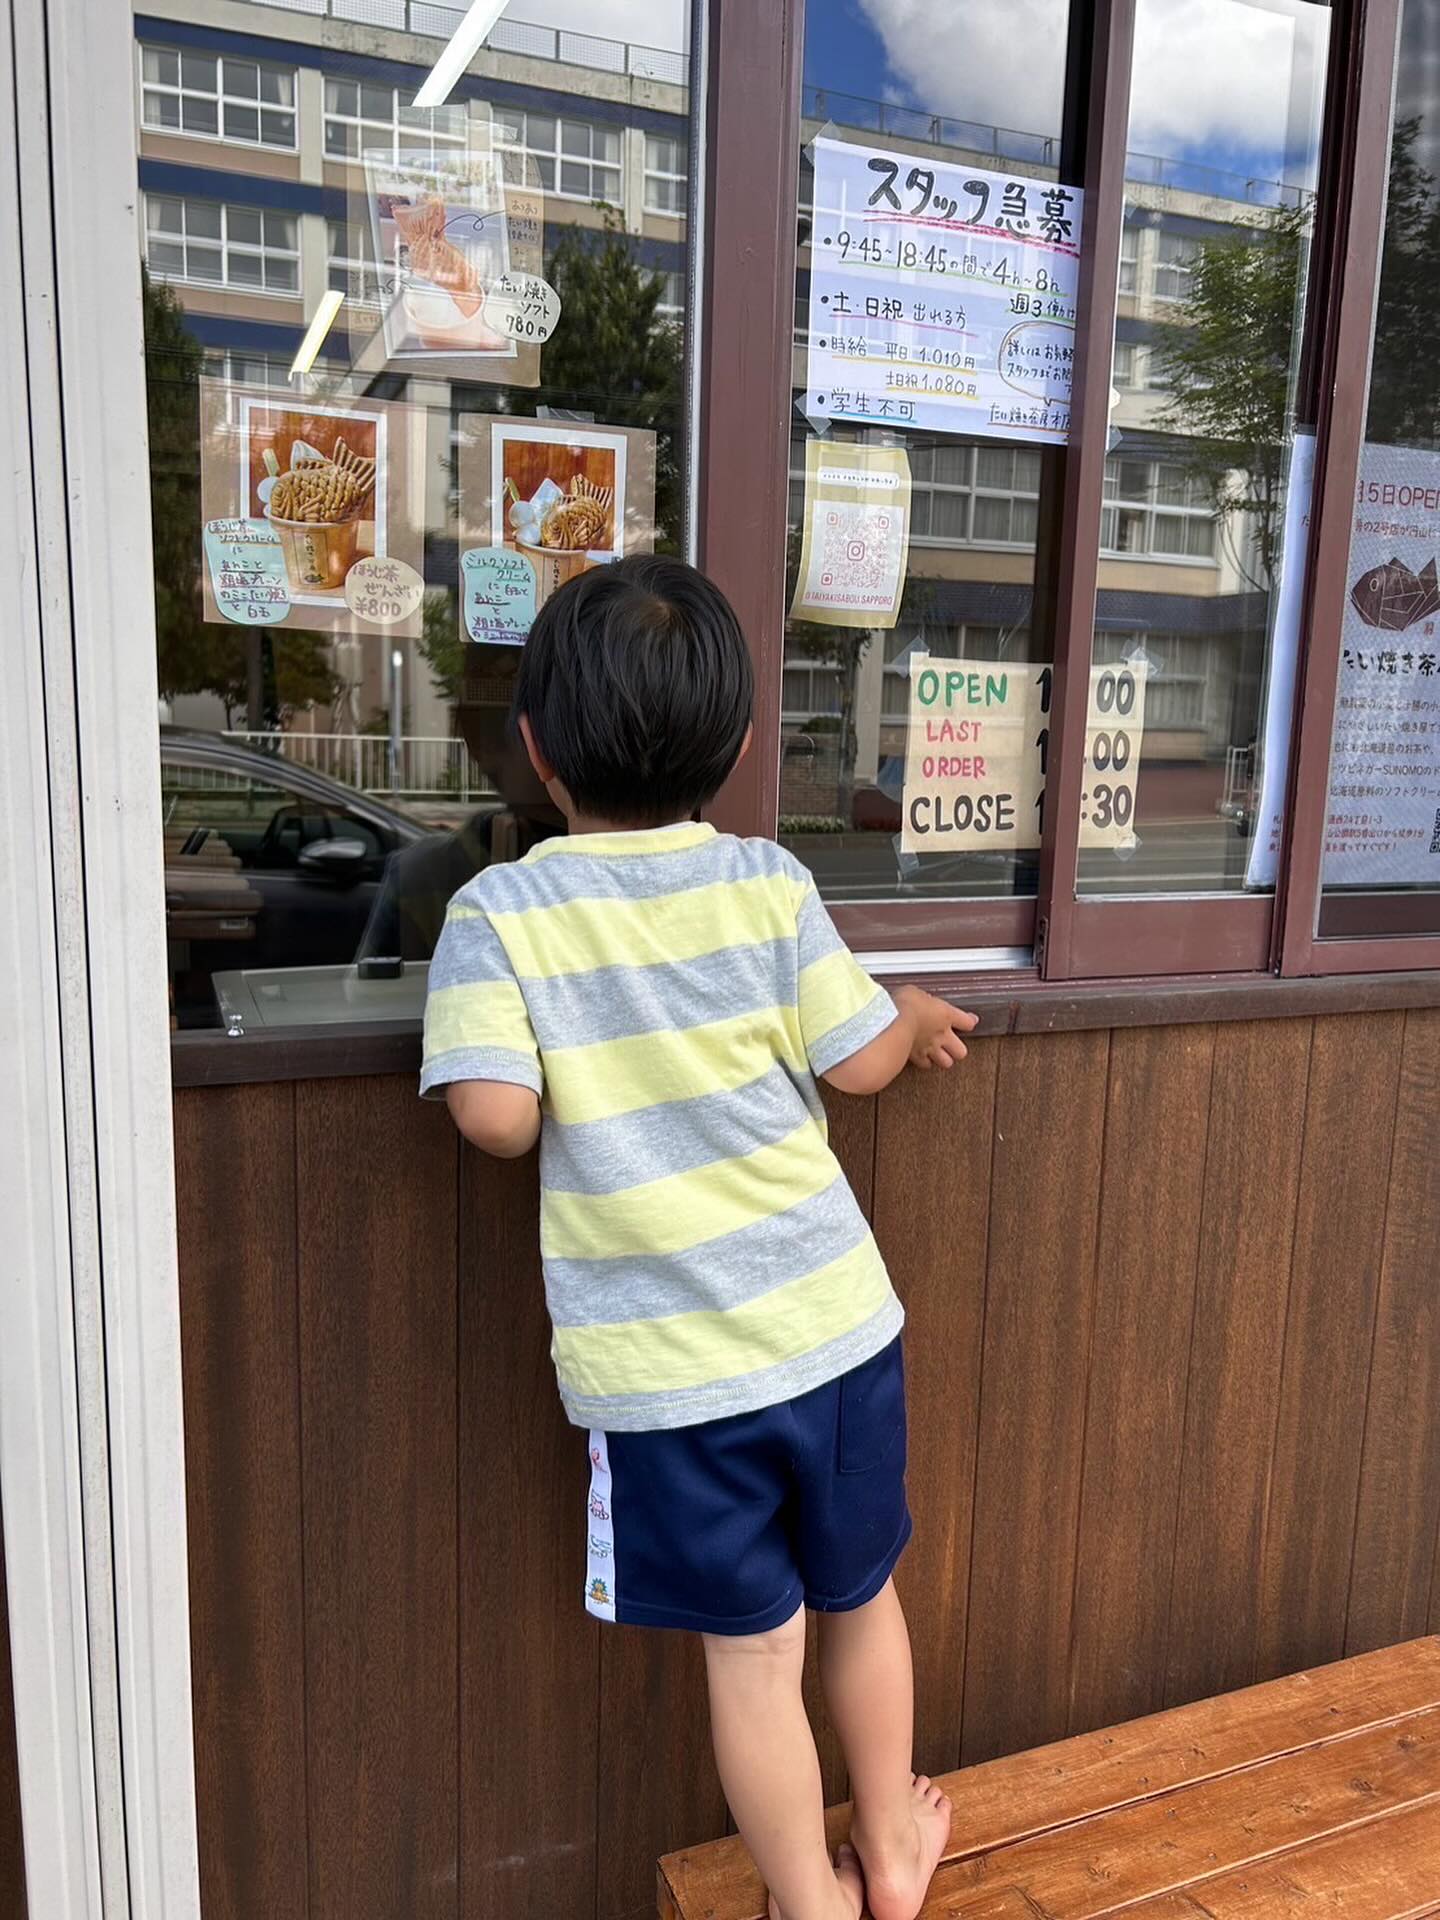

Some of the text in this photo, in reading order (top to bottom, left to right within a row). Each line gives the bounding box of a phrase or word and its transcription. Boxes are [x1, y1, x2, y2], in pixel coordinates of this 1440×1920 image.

[866, 157, 1075, 243] スタッフ急募
[500, 275, 548, 302] たい焼き
[521, 303, 551, 319] ソフト
[505, 314, 548, 338] 780円
[830, 335, 868, 357] 時給
[885, 342, 909, 360] 平日
[830, 388, 917, 421] 学生不可
[465, 551, 528, 570] ミルクソフト
[353, 563, 401, 583] ほうじ茶
[496, 569, 532, 583] クリーム
[364, 582, 420, 599] ぜんざい
[355, 596, 402, 617] ¥800
[917, 669, 1010, 708] OPEN
[926, 720, 982, 743] LAST
[922, 755, 986, 778] ORDER
[910, 793, 1015, 833] CLOSE
